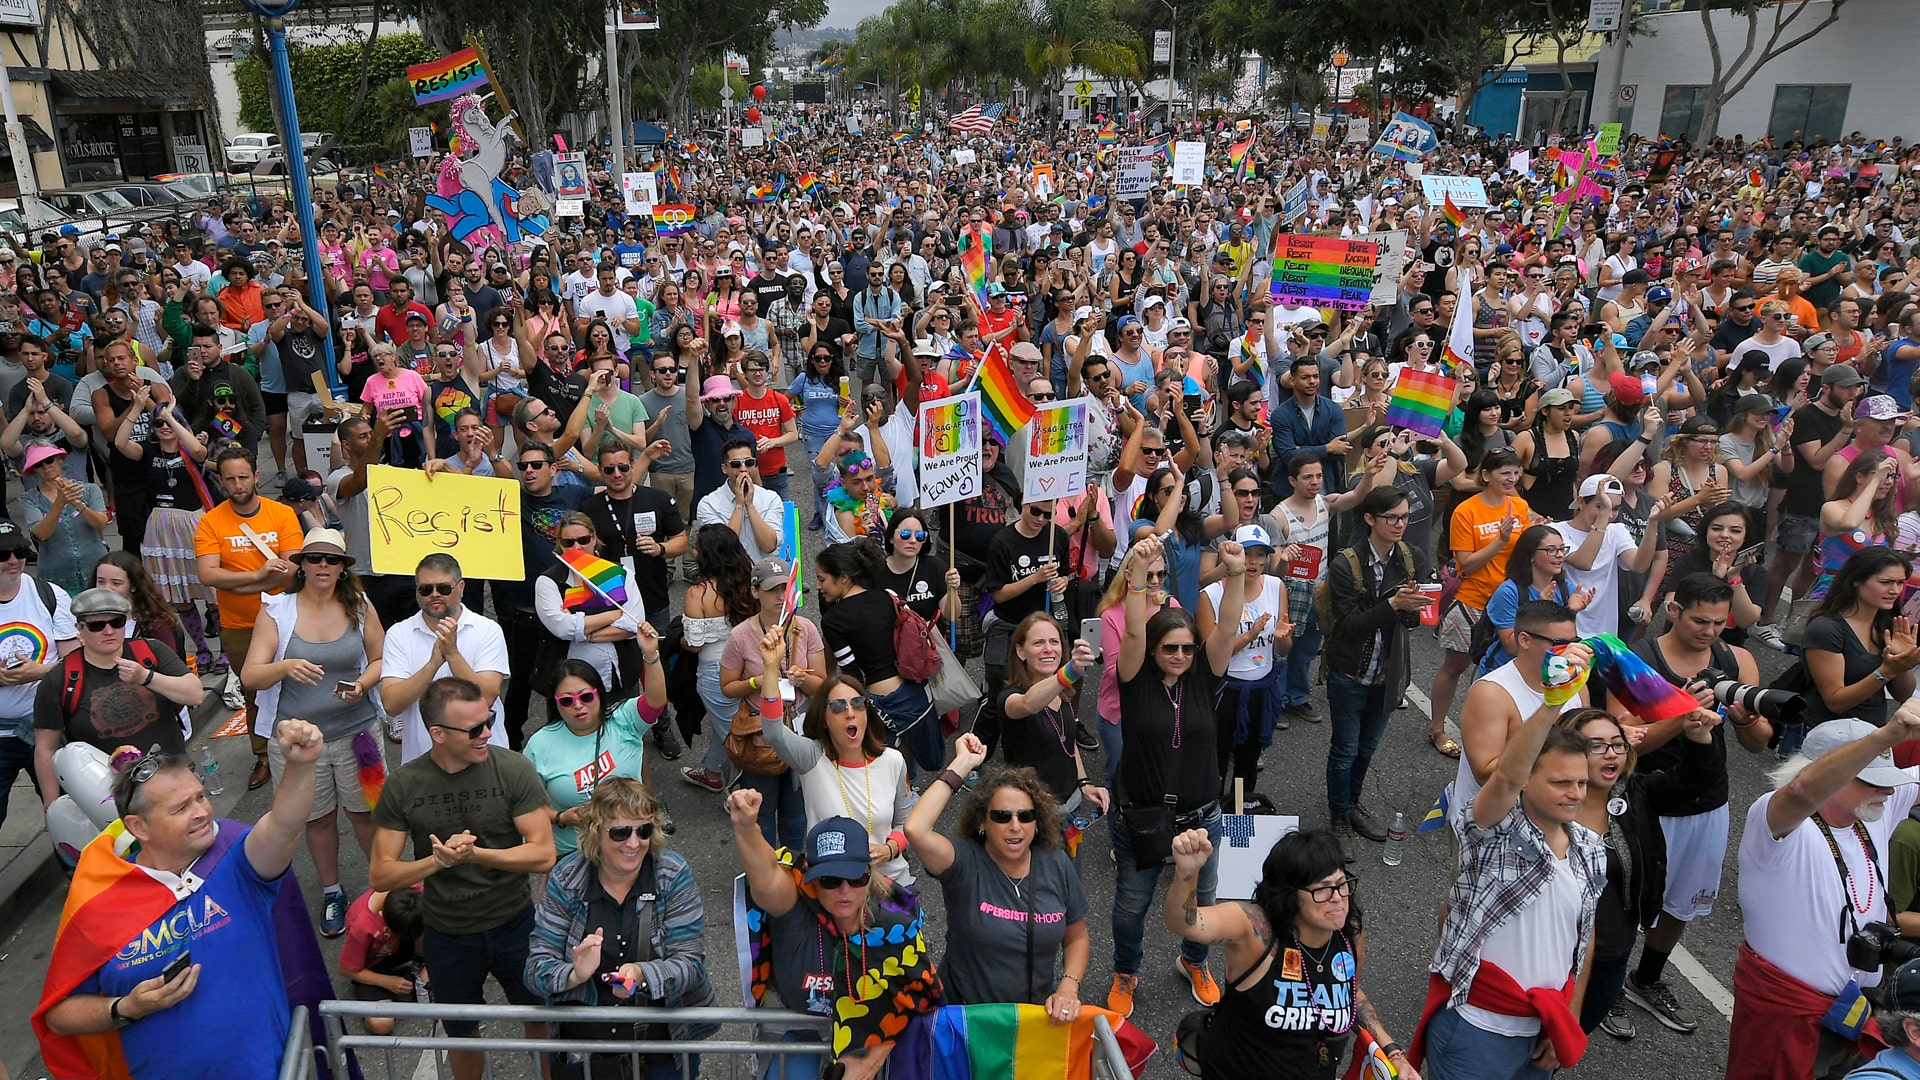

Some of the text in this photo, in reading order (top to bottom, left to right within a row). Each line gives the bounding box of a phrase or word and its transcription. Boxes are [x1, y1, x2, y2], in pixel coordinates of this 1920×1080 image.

[414, 60, 478, 96] RESIST
[1600, 135, 1617, 144] NOT
[1118, 149, 1142, 157] RALLY
[1118, 154, 1153, 164] EVERYONE
[1117, 163, 1137, 171] SAME
[1116, 176, 1150, 184] STOPPING
[1116, 183, 1139, 191] TRUMP
[1430, 177, 1472, 187] TUCK
[1288, 235, 1315, 249] RESIST
[1348, 242, 1369, 253] HATE
[1286, 247, 1370, 264] RESIST RACISM
[1284, 259, 1374, 279] RESIST INEQUALITY
[1281, 271, 1372, 289] RESIST BIGOTRY
[1280, 282, 1362, 301] RESIST FEAR
[1290, 296, 1310, 307] LOVE
[1332, 300, 1349, 310] HATE
[378, 397, 412, 408] IMMIGRANTS
[382, 392, 396, 400] KEEP
[738, 409, 757, 420] LOVE
[762, 407, 781, 418] LOVE
[924, 451, 979, 471] We Are Proud
[1029, 452, 1084, 469] We Are Proud
[966, 507, 1006, 524] TRU
[1477, 518, 1524, 535] TRER
[228, 531, 279, 548] TREOR
[770, 561, 783, 573] LA
[412, 787, 504, 809] DIESEL
[116, 894, 228, 961] GMCLA
[131, 953, 155, 967] MEN'S
[1273, 979, 1352, 1010] TEAM
[1264, 1004, 1351, 1032] GRIFFIN
